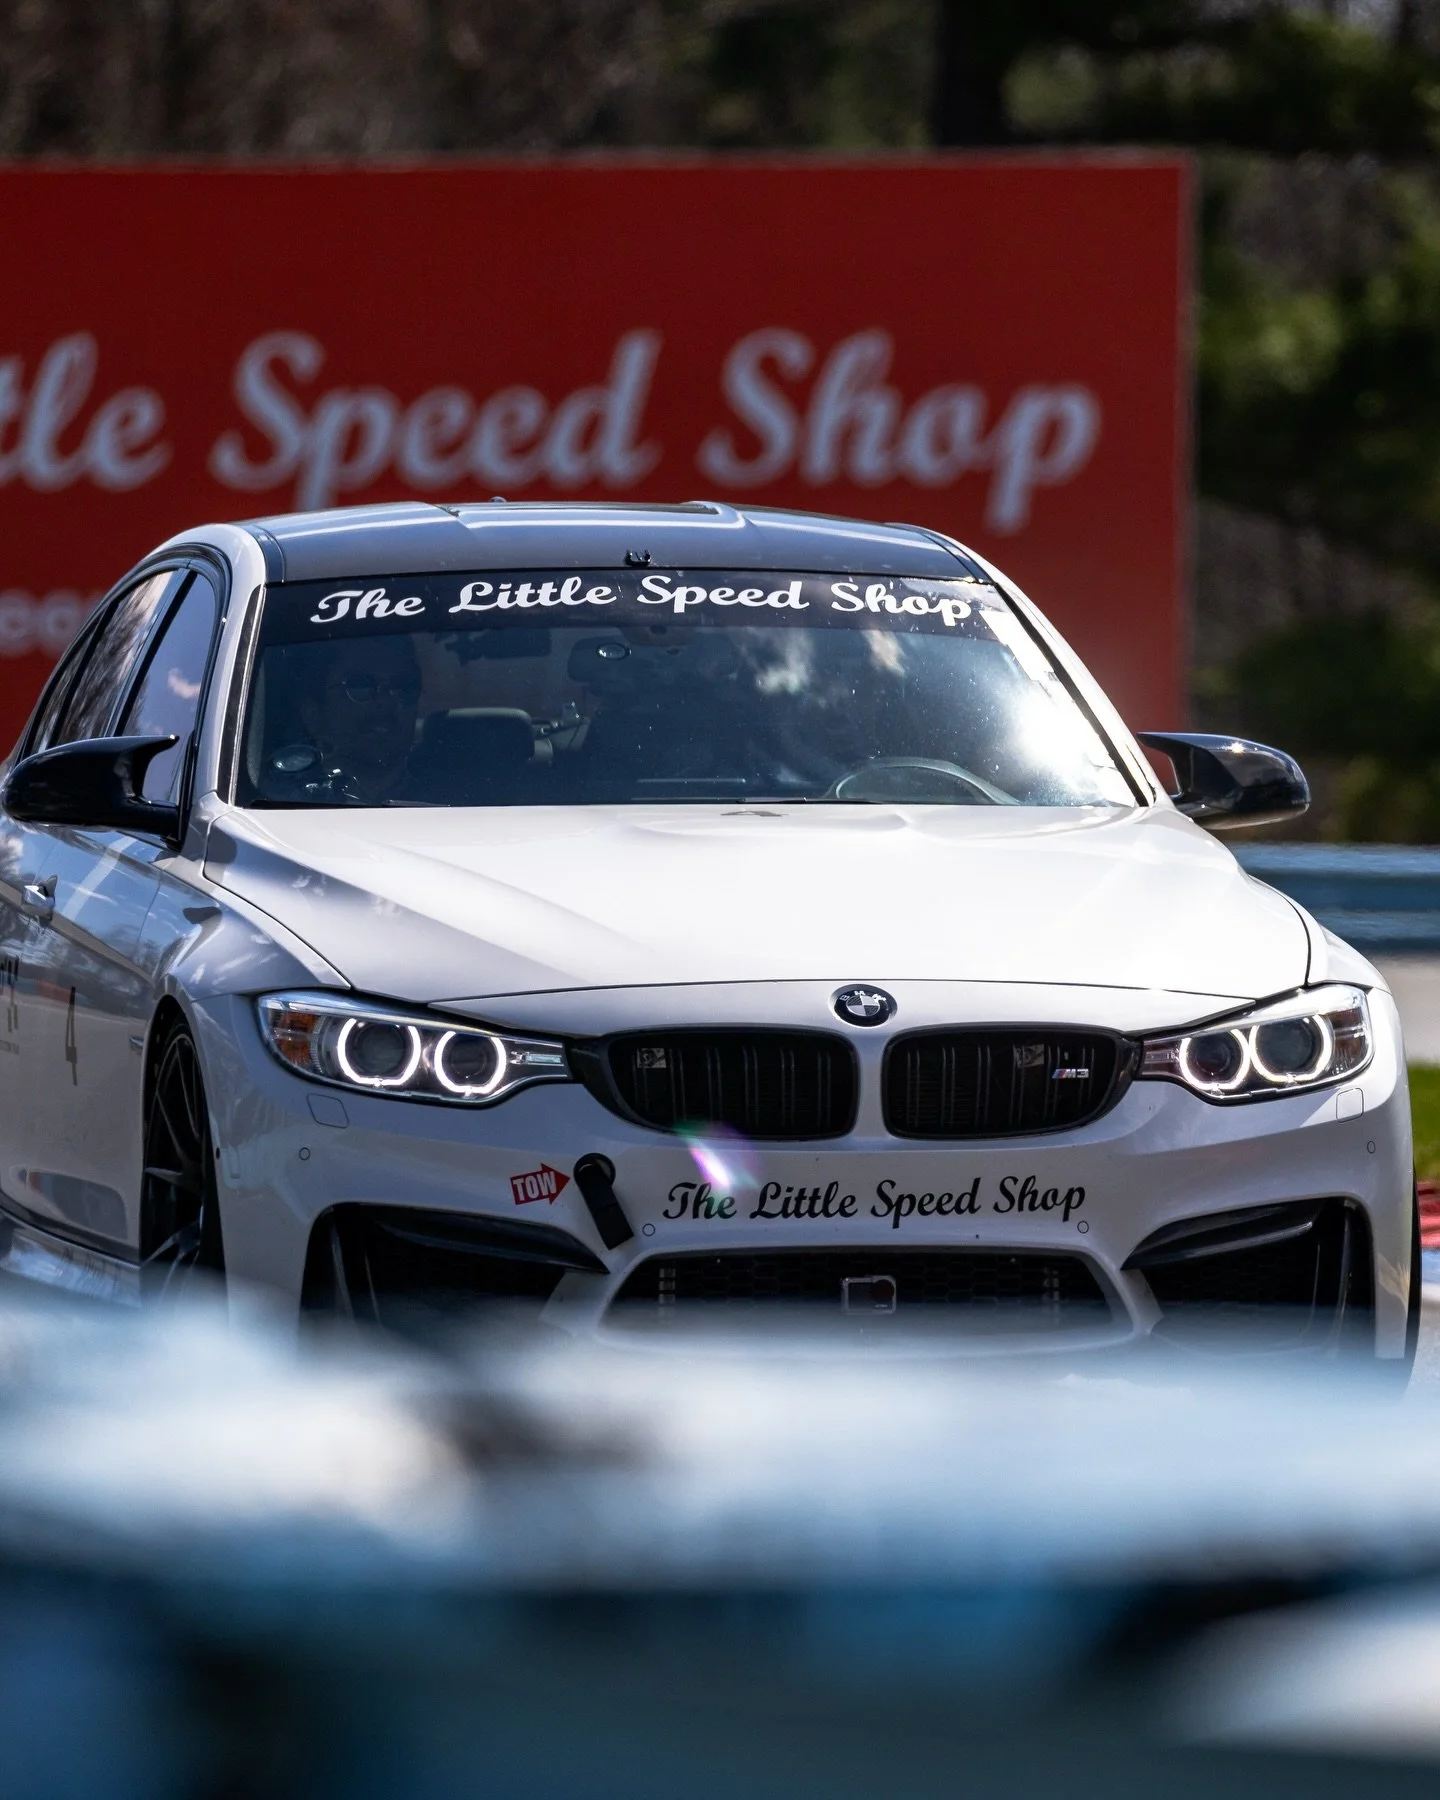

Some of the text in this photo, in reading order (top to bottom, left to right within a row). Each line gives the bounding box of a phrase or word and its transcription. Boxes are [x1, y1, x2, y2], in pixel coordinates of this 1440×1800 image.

[209, 329, 662, 509] Speed
[698, 326, 1102, 537] Shop
[310, 575, 972, 626] The Little Speed Shop
[513, 1171, 557, 1202] TOW
[663, 1174, 1086, 1230] The Little Speed Shop
